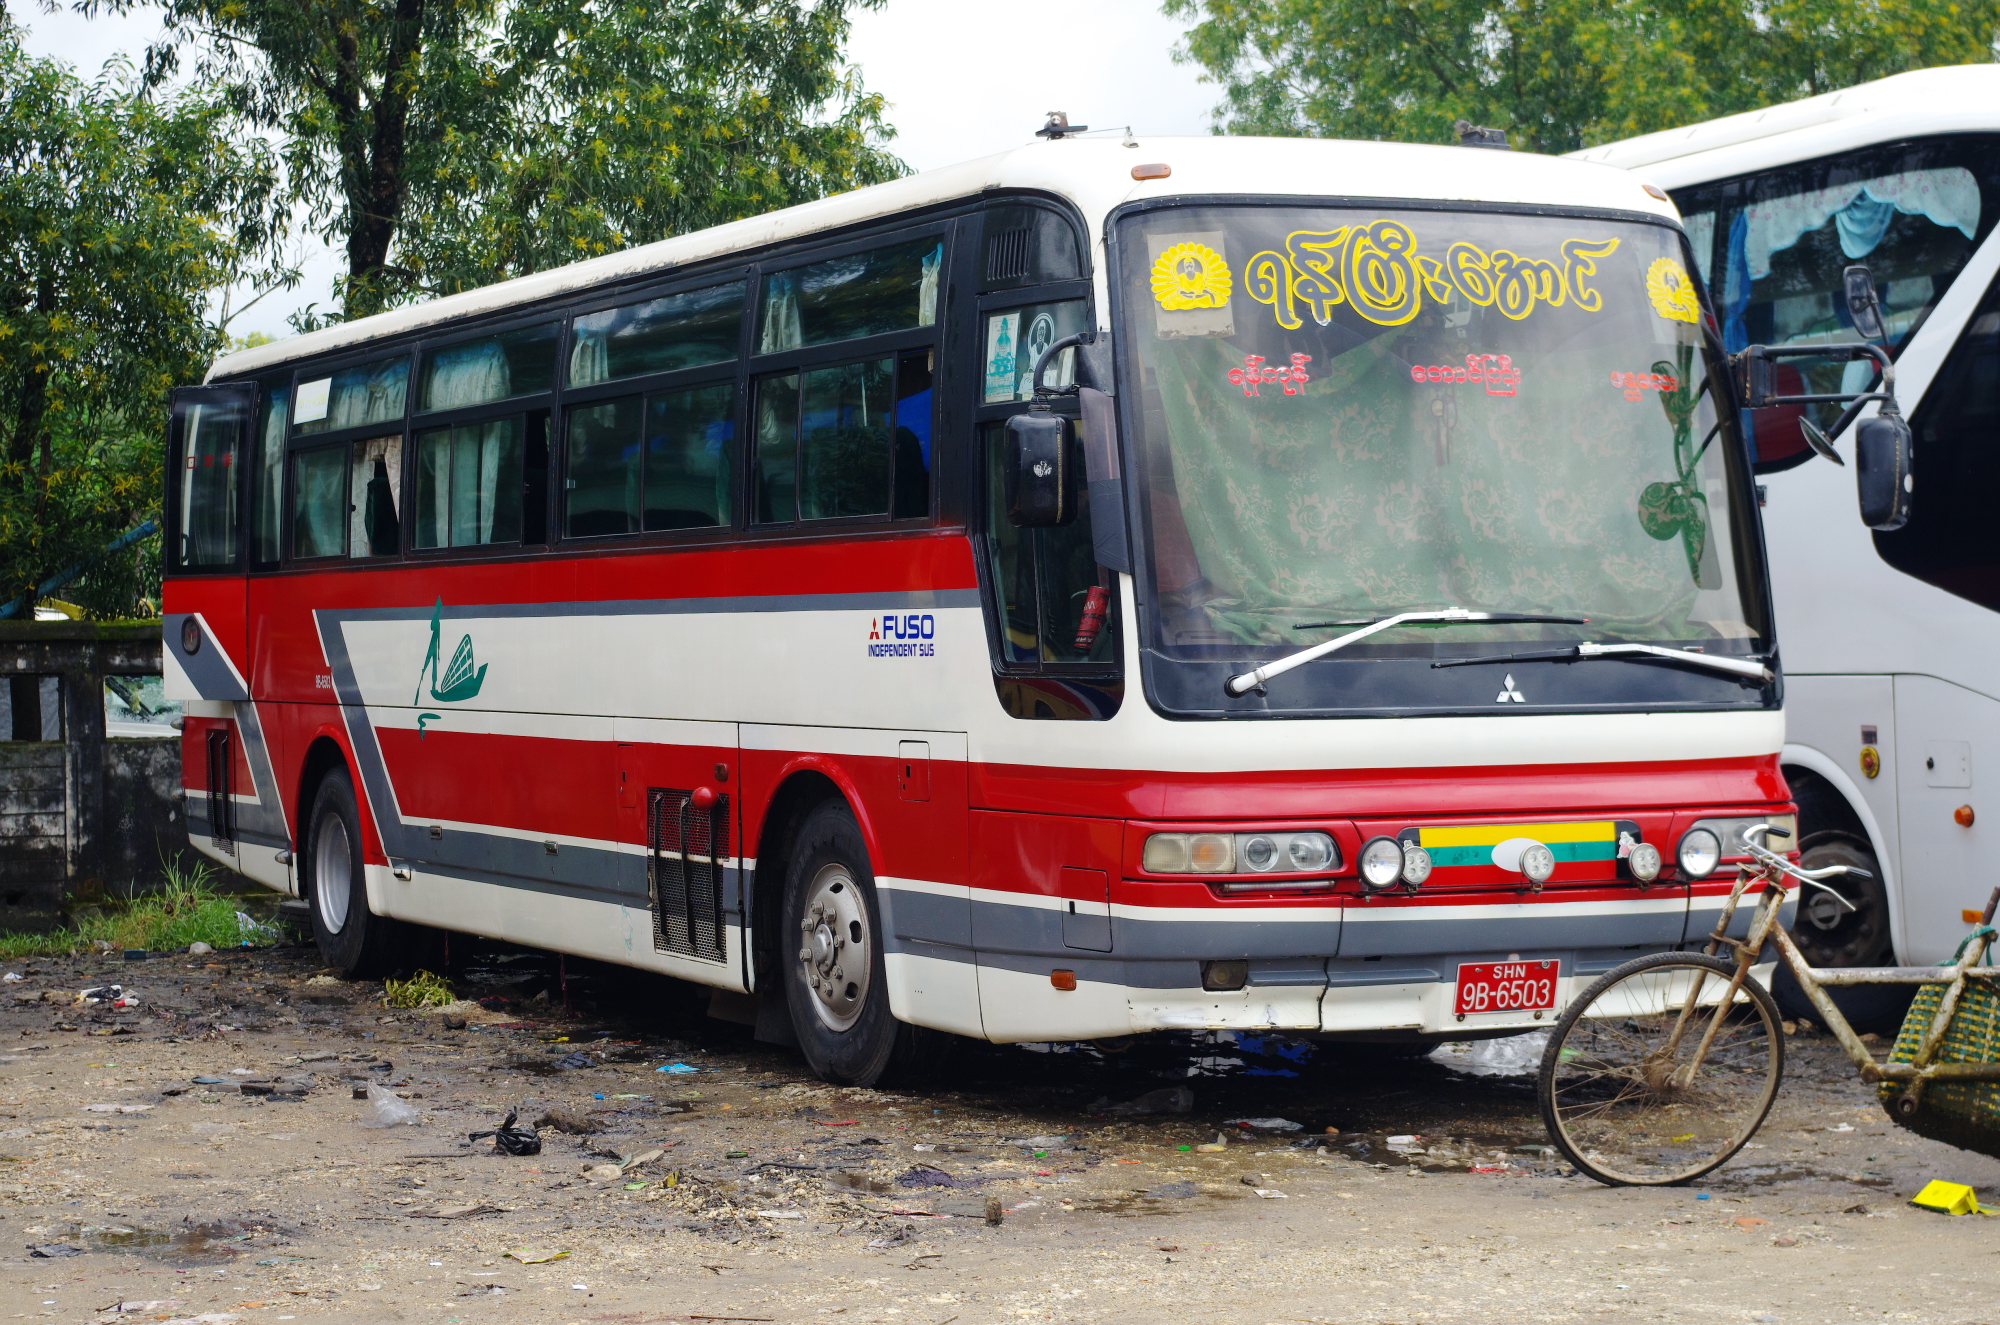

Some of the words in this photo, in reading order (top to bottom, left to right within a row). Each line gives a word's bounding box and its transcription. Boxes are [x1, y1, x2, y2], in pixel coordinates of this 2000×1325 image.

[1227, 352, 1312, 397] ရန်ကုန်
[883, 615, 935, 640] FUSO
[868, 644, 917, 657] INDEPENDENT
[919, 643, 935, 657] SUS
[1492, 965, 1526, 979] SHN
[1462, 979, 1551, 1010] 9B-6503
